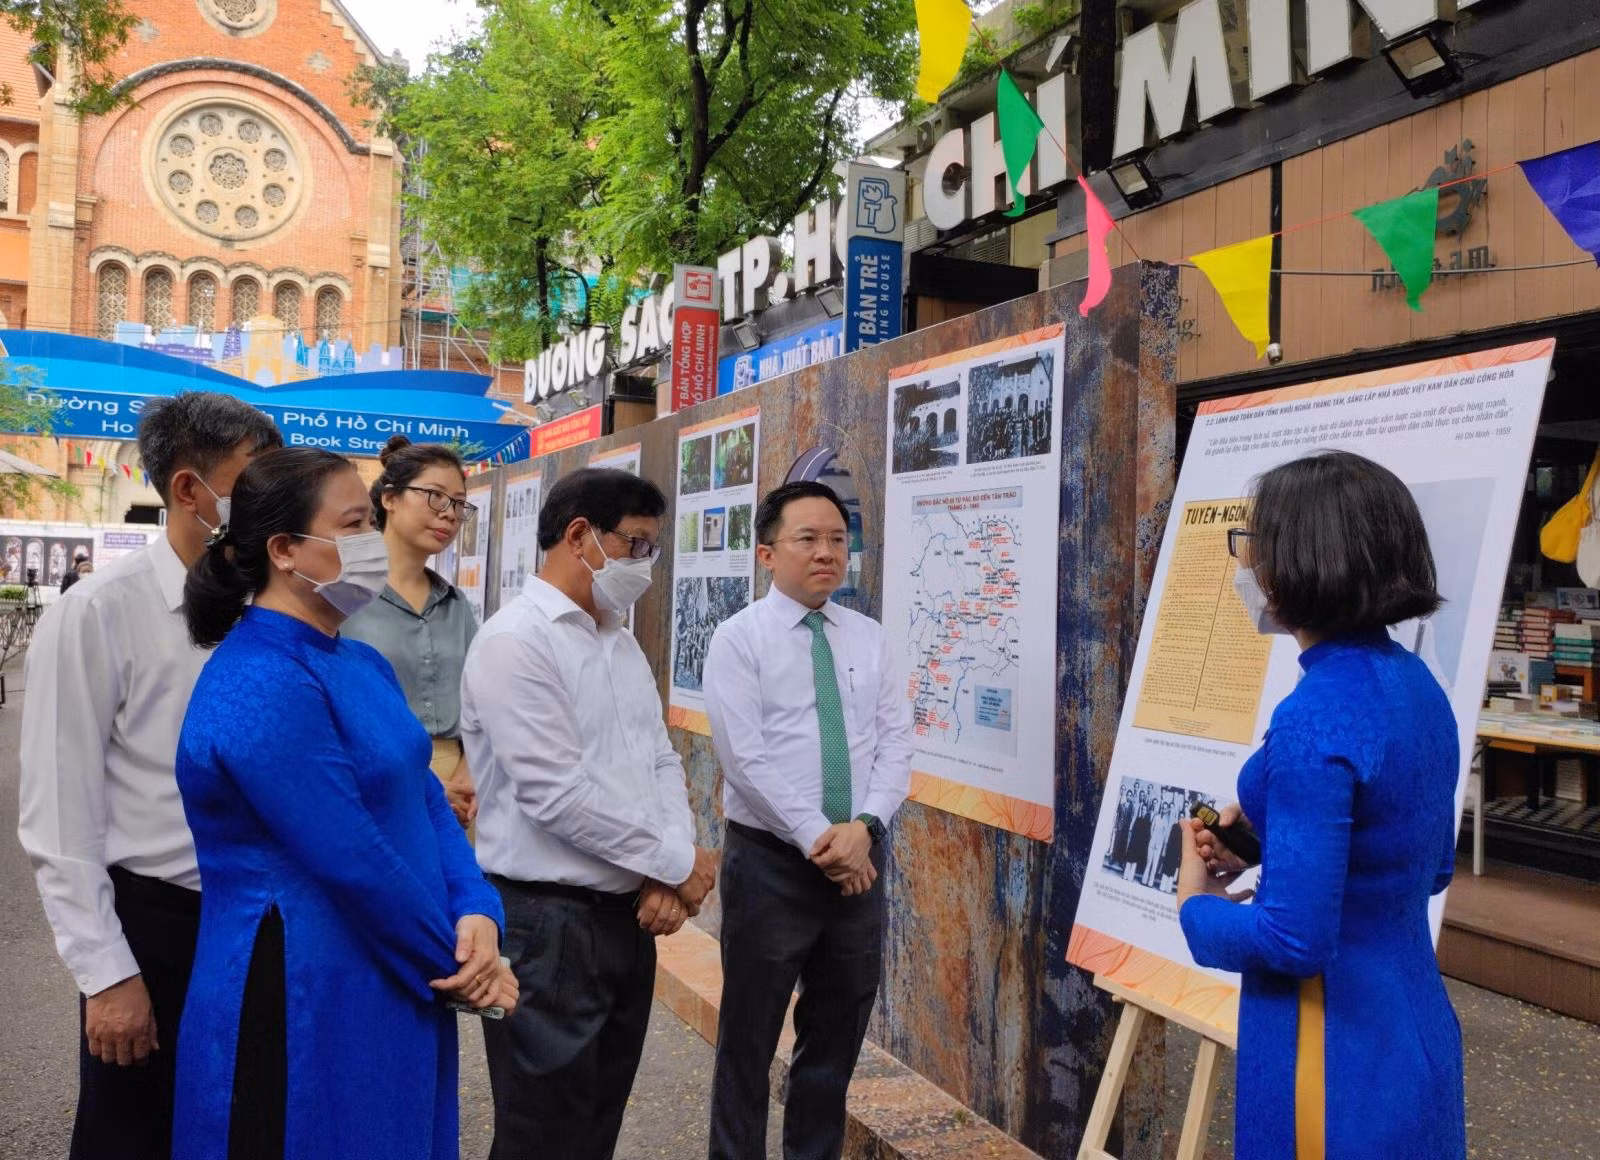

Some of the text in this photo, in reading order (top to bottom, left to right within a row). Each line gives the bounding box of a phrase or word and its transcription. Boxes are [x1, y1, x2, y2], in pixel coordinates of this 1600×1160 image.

[854, 254, 878, 289] TRẺ
[880, 255, 890, 301] HOUSE
[620, 272, 675, 363] SÁC
[681, 321, 692, 343] HỢP
[854, 294, 877, 335] BẢN
[696, 324, 705, 351] MINH
[694, 354, 704, 372] CHÍ
[677, 378, 690, 399] BẢN
[1347, 393, 1363, 403] SÁNG
[1412, 384, 1426, 393] VIỆT
[1427, 381, 1442, 391] NAM
[1444, 378, 1458, 388] DÂN
[1460, 374, 1475, 386] CHỦ
[1477, 372, 1497, 383] CỘNG
[1499, 368, 1514, 379] HÒA
[26, 392, 119, 415] Đường
[283, 412, 329, 428] Phố
[336, 415, 368, 430] Hồ
[375, 419, 412, 434] Chí
[418, 422, 469, 438] Minh
[102, 420, 386, 450] Ho Book Stre
